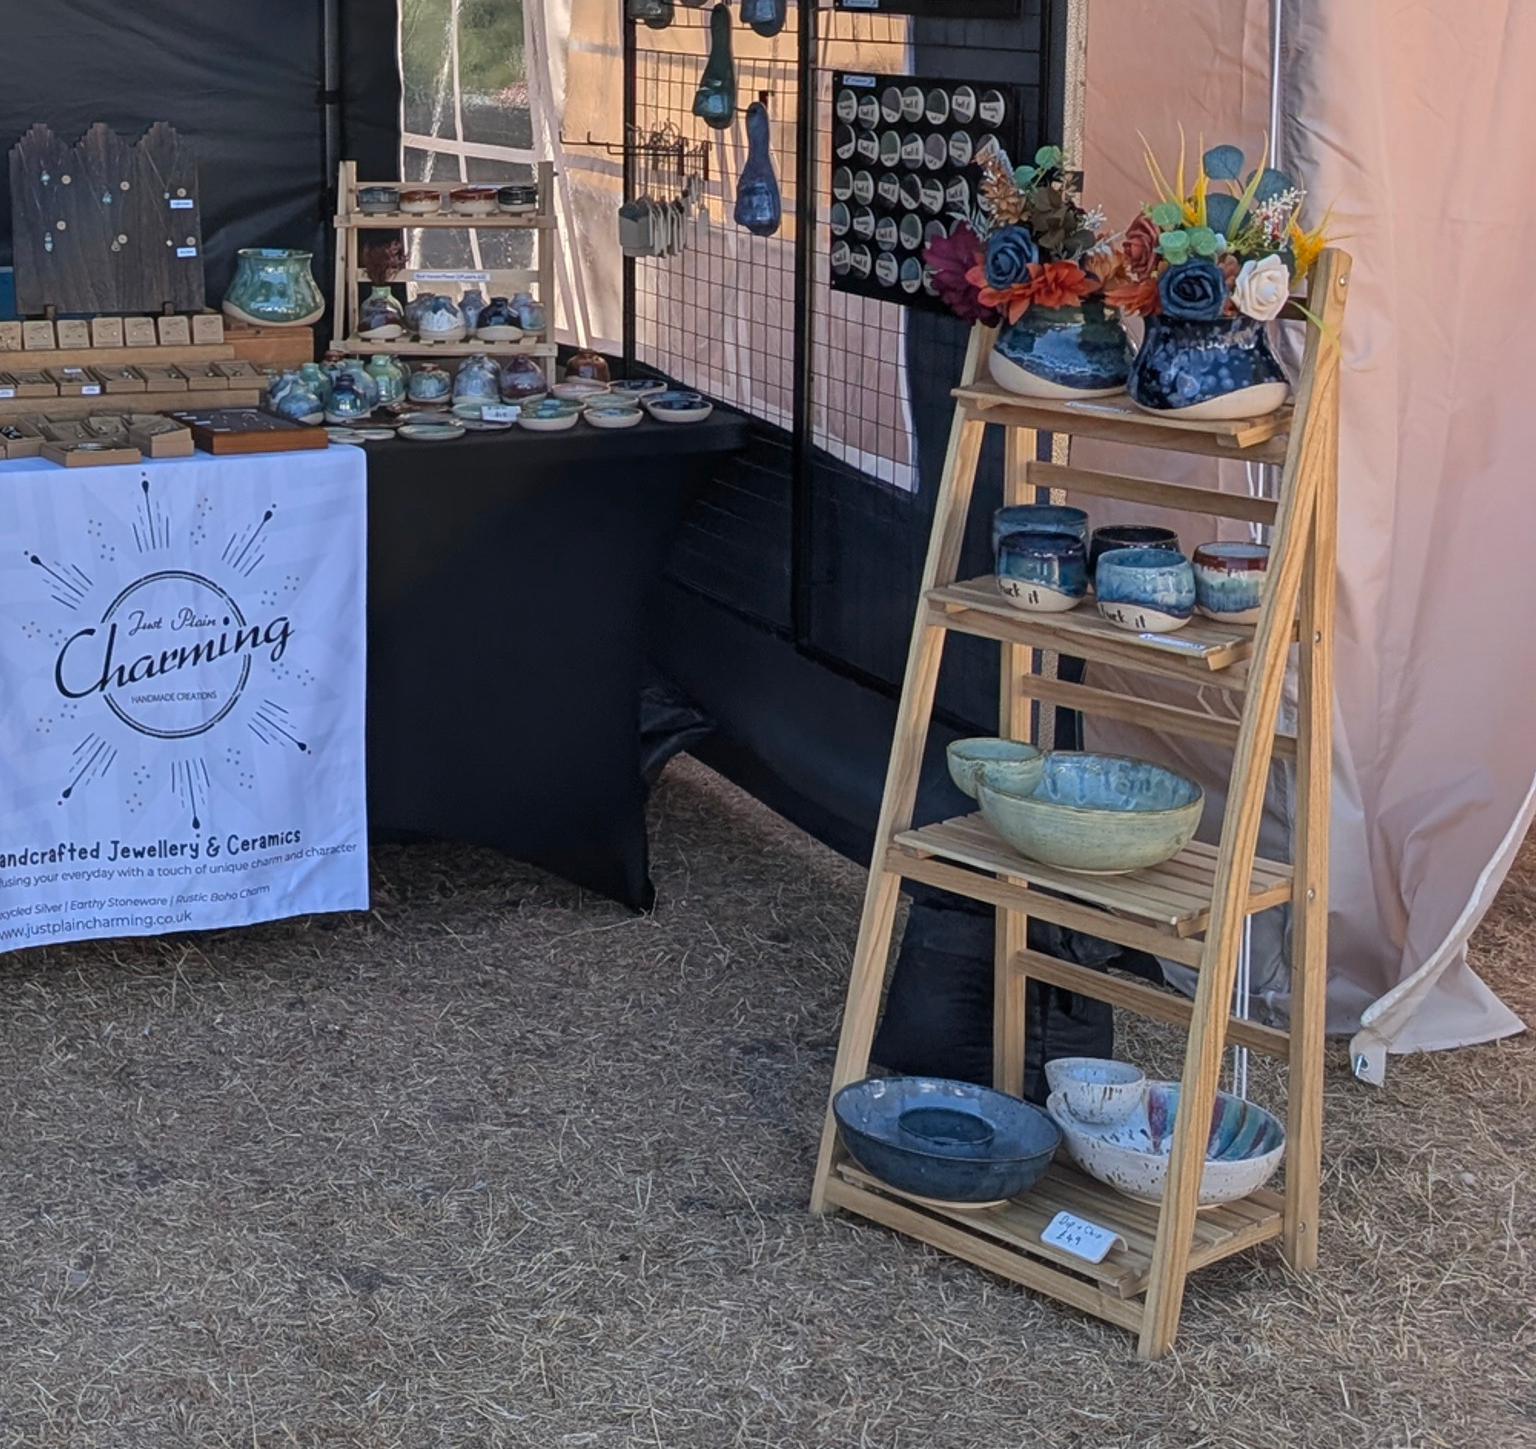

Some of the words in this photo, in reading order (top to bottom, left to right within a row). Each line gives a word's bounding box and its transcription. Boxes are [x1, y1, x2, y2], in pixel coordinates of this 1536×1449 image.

[1027, 589, 1040, 605] it
[128, 609, 163, 637] Just
[170, 606, 217, 631] Plain
[1135, 614, 1146, 629] it
[54, 615, 296, 699] Charming
[131, 692, 175, 704] HANDMADE
[176, 690, 217, 702] CREATIONS
[107, 838, 200, 862] Jewellery
[206, 835, 221, 858] &
[227, 828, 301, 856] Ceramics
[33, 872, 59, 887] your
[61, 867, 115, 883] everyday
[117, 865, 144, 878] with
[147, 869, 154, 878] a
[158, 864, 192, 878] touch
[195, 863, 207, 875] of
[209, 861, 249, 875] unique
[251, 854, 283, 869] charm
[285, 850, 304, 863] and
[305, 843, 358, 859] character
[35, 901, 63, 915] Silver
[70, 899, 105, 913] Earthy
[107, 896, 168, 909] Stoneware
[176, 892, 209, 905] Rustic
[210, 889, 238, 902] Boho
[239, 884, 271, 899] Charm
[1058, 1215, 1076, 1230] Dip
